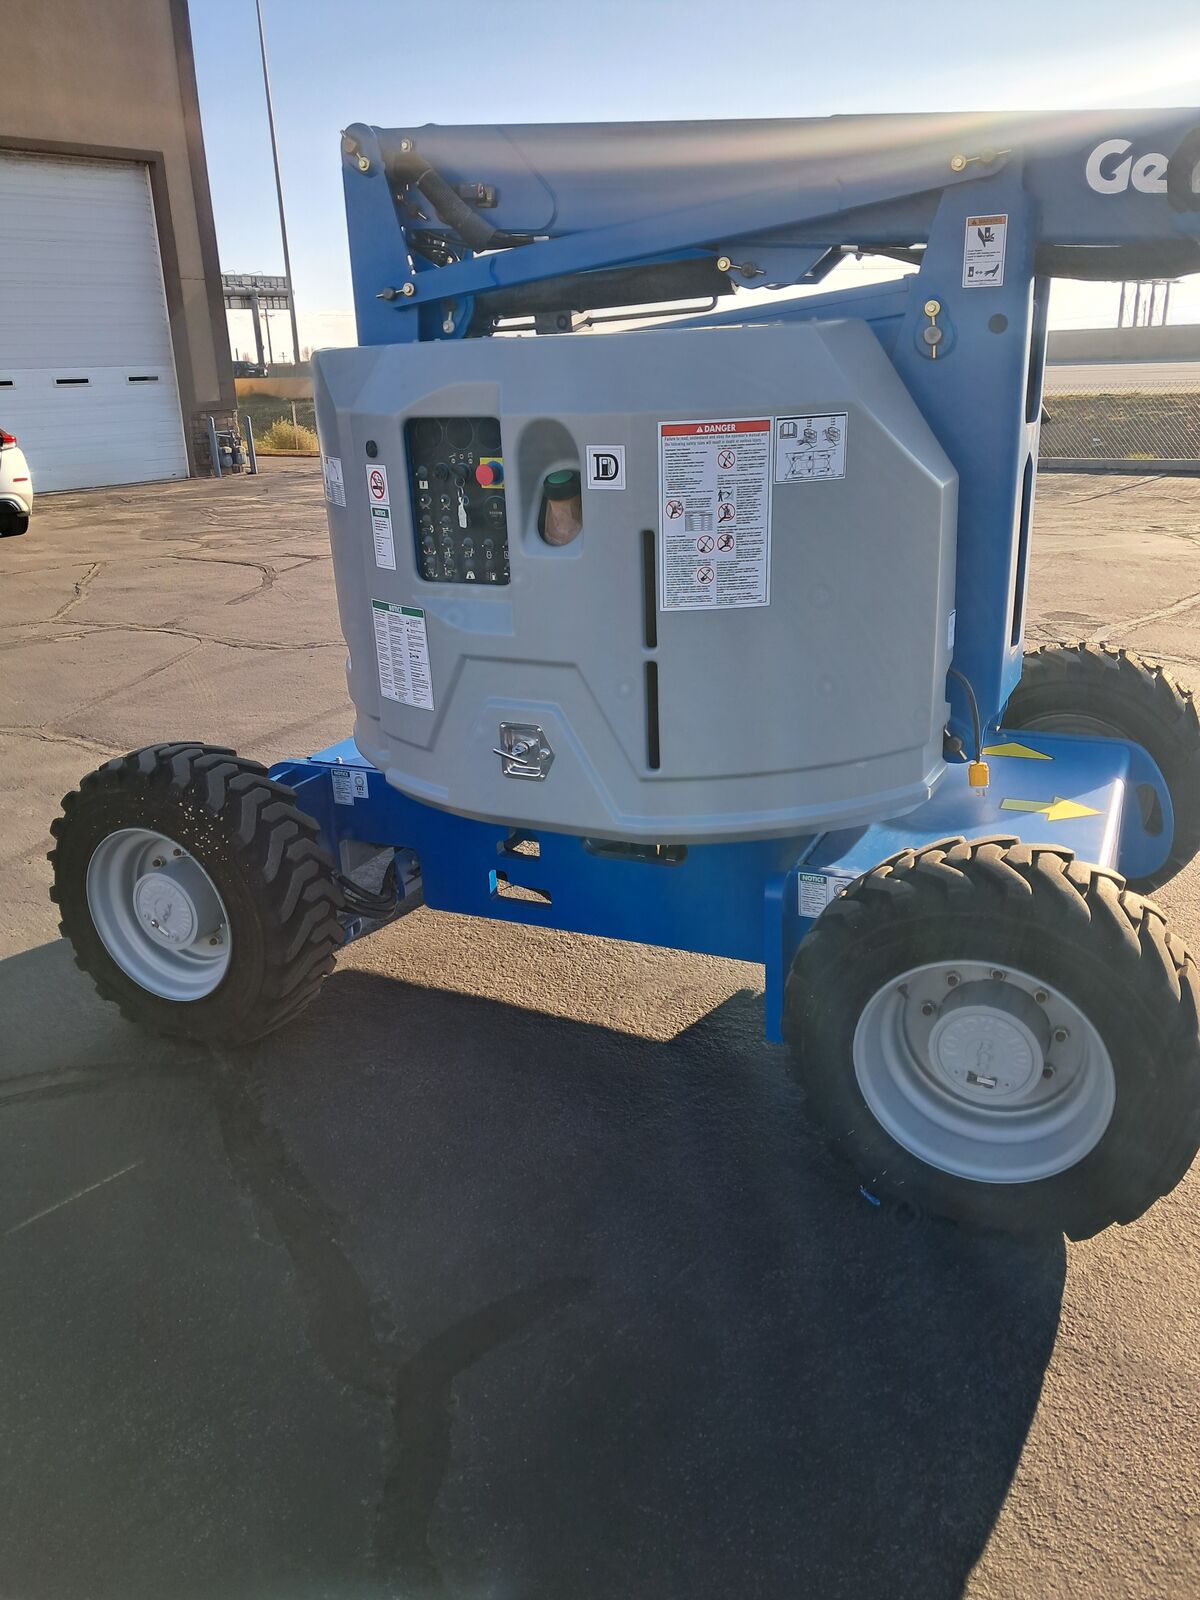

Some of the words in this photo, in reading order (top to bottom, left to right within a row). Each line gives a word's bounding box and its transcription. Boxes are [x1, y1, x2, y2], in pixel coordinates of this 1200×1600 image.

[1086, 138, 1200, 195] Ge
[704, 424, 736, 433] DANGER
[802, 875, 824, 883] NOTICE
